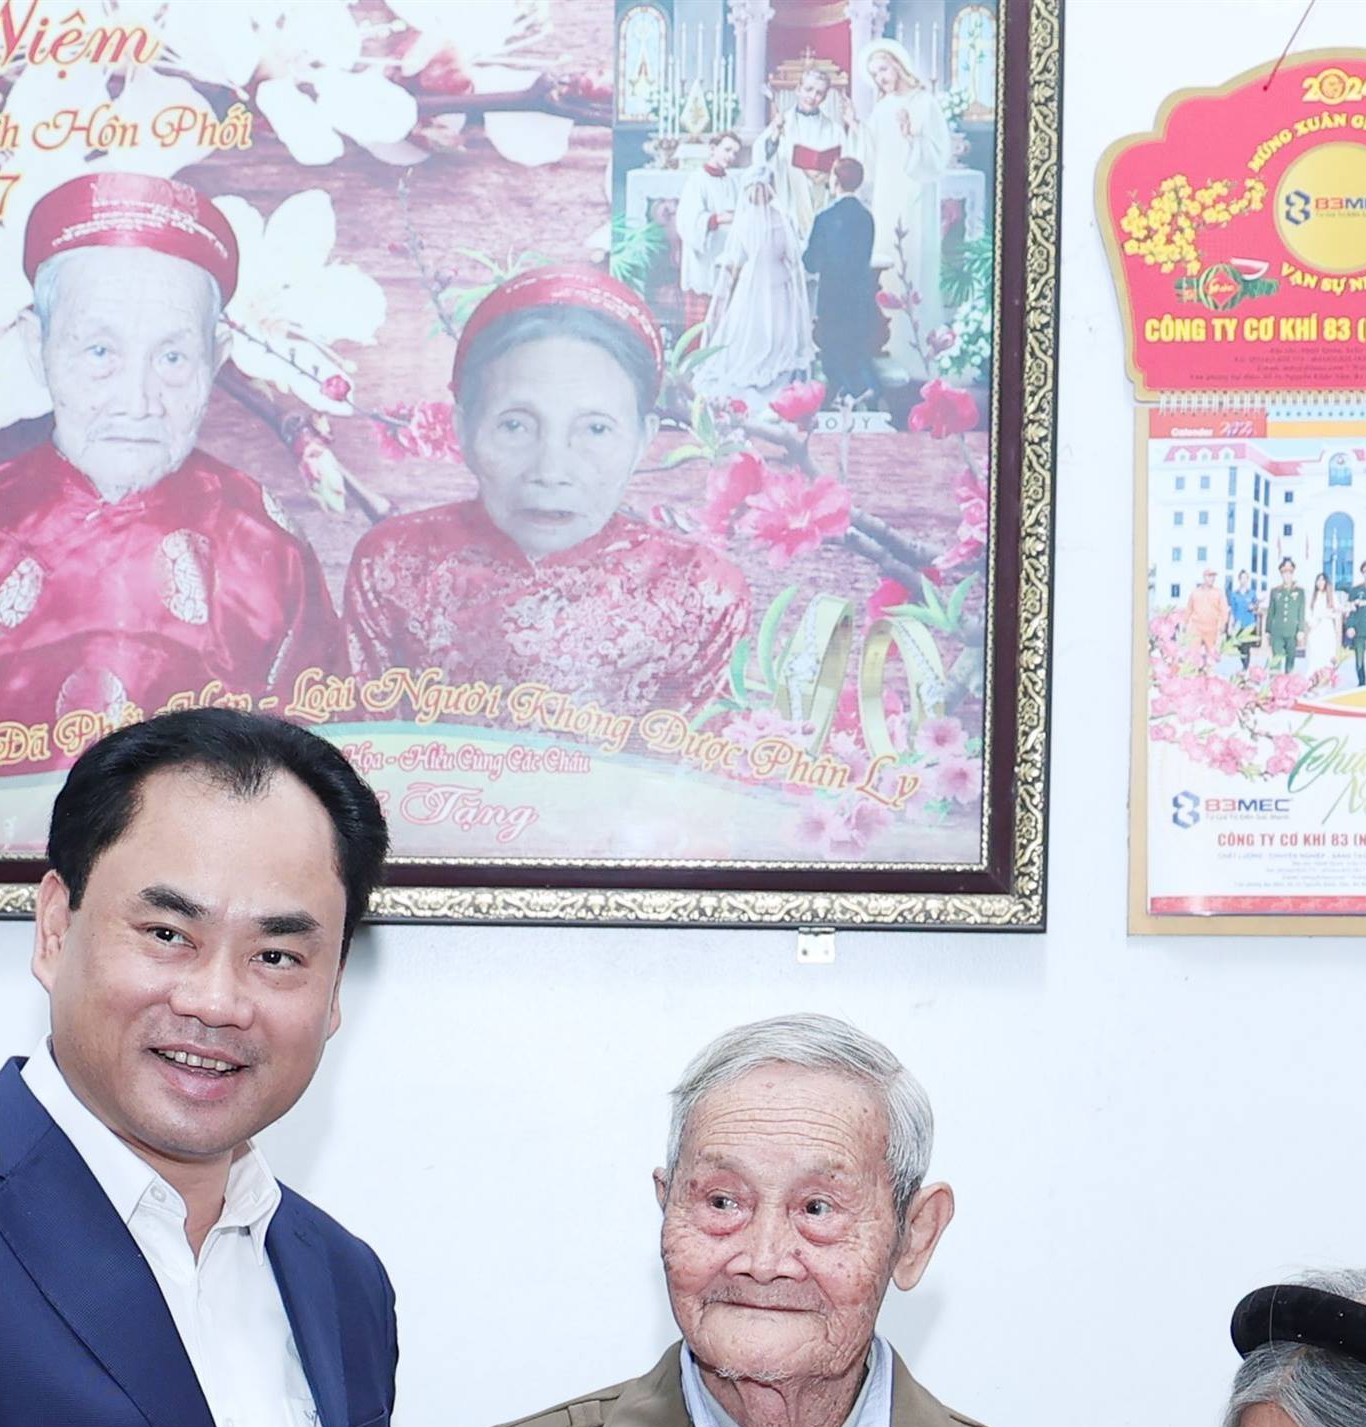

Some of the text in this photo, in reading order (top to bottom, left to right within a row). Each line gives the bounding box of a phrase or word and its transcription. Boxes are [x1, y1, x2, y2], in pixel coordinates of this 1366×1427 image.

[32, 103, 139, 151] Hôn
[151, 104, 252, 149] Phối
[1293, 111, 1348, 137] XUÂN
[1144, 313, 1207, 343] CÔNG
[1210, 317, 1240, 343] TY
[1243, 315, 1276, 343] CƠ
[1279, 312, 1319, 342] KHÍ
[1322, 317, 1352, 342] 83
[284, 667, 357, 723] Loài
[361, 667, 501, 727] Người
[508, 681, 635, 753] Không
[639, 707, 745, 772] Được
[747, 736, 851, 791] Phân
[399, 782, 539, 843] Tặng
[1204, 797, 1292, 813] 83MEC
[1259, 832, 1277, 848] TY
[1330, 832, 1349, 848] 83
